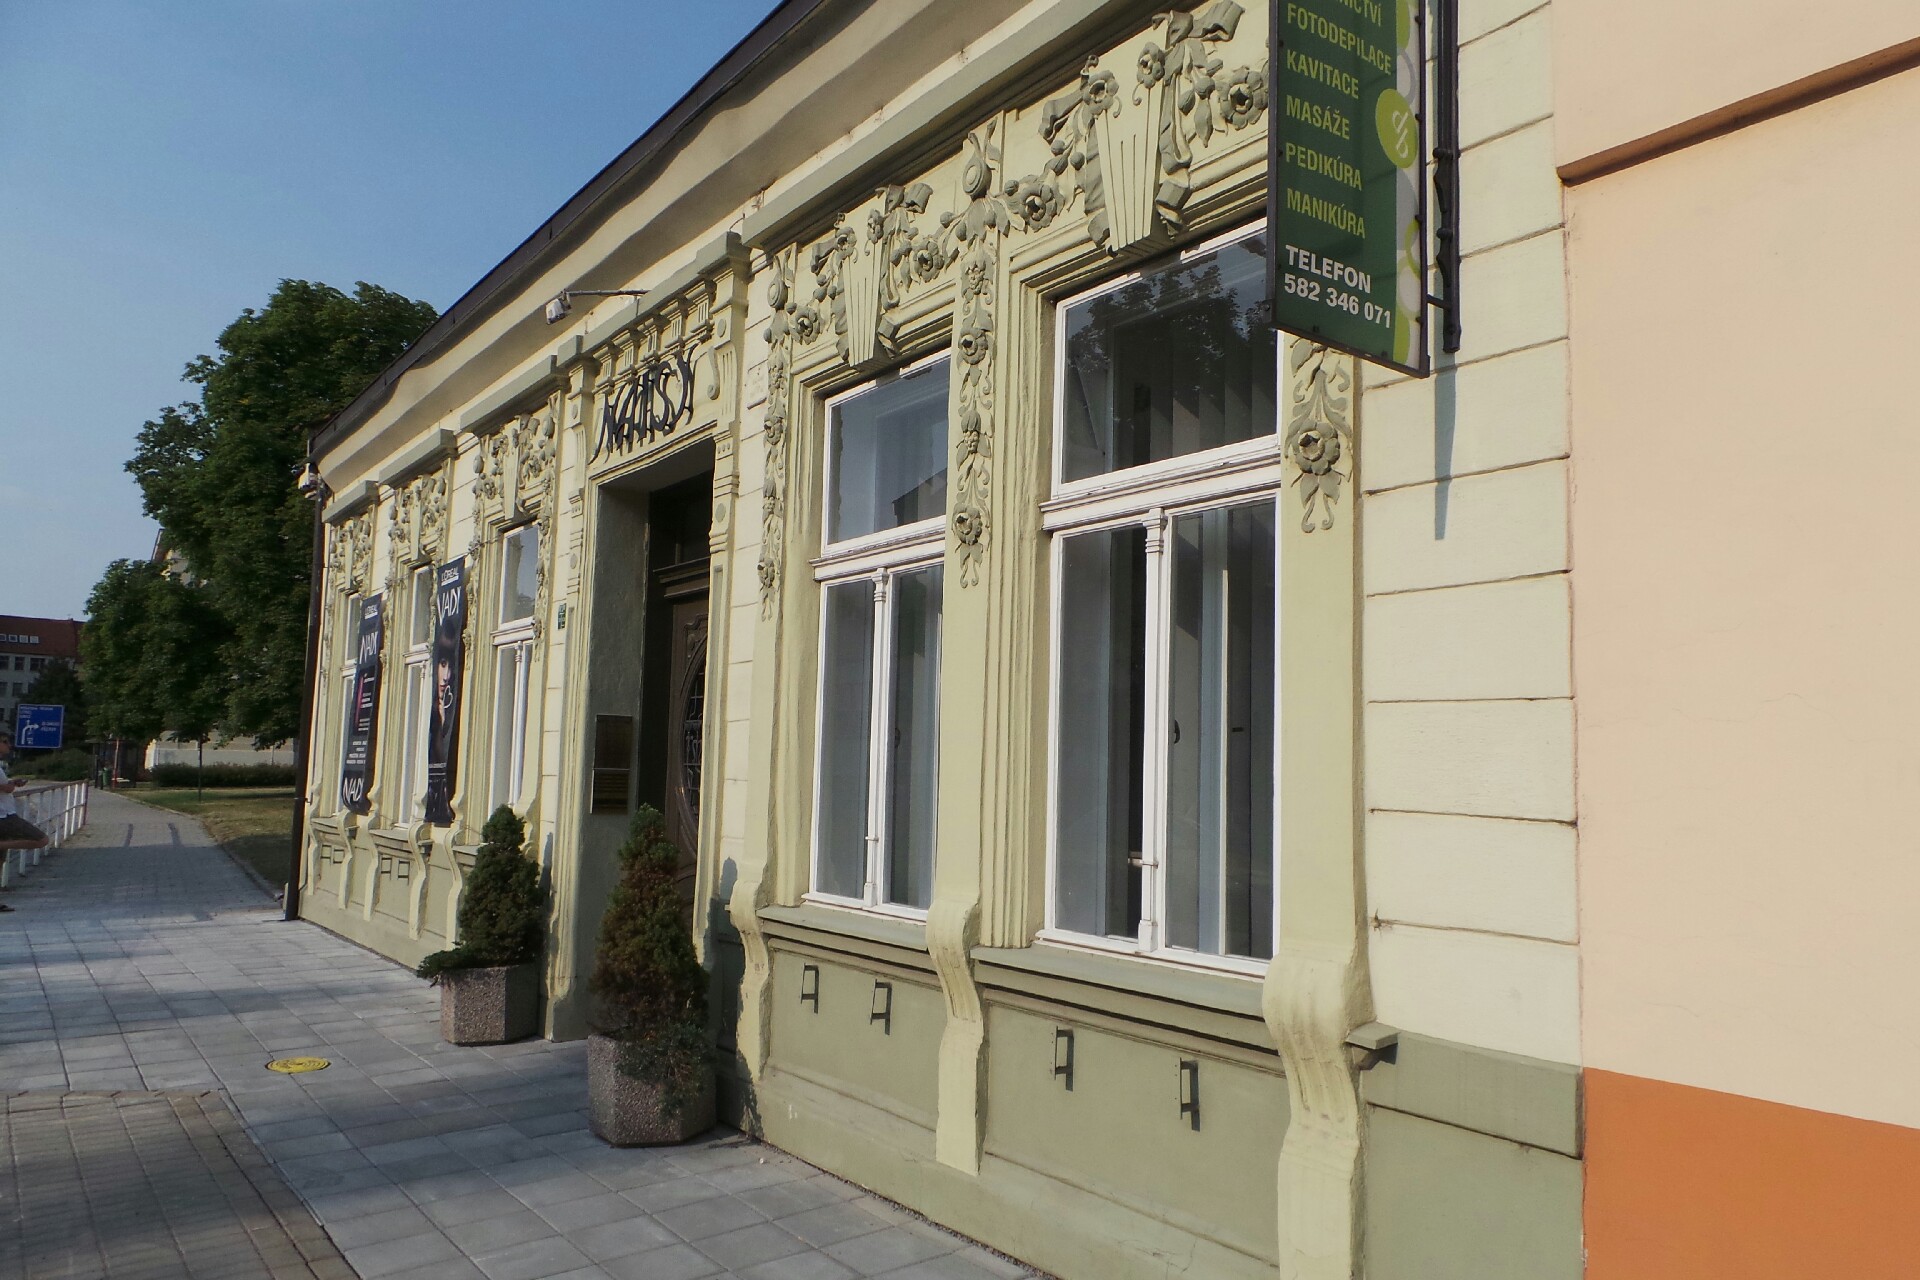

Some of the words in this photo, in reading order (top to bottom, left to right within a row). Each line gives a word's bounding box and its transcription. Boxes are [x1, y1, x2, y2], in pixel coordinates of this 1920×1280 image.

[1287, 2, 1391, 75] FOTODEPILACE
[1340, 0, 1381, 27] CTVÍ
[1286, 49, 1359, 99] KAVITACE
[1286, 94, 1350, 140] MASÁŽE
[1286, 142, 1362, 191] PEDIKÚRA
[1287, 187, 1365, 239] MANIKÚRA
[1285, 244, 1371, 294] TELEFON
[1284, 273, 1320, 302] 582
[1325, 287, 1359, 315] 346
[1364, 301, 1391, 329] 071
